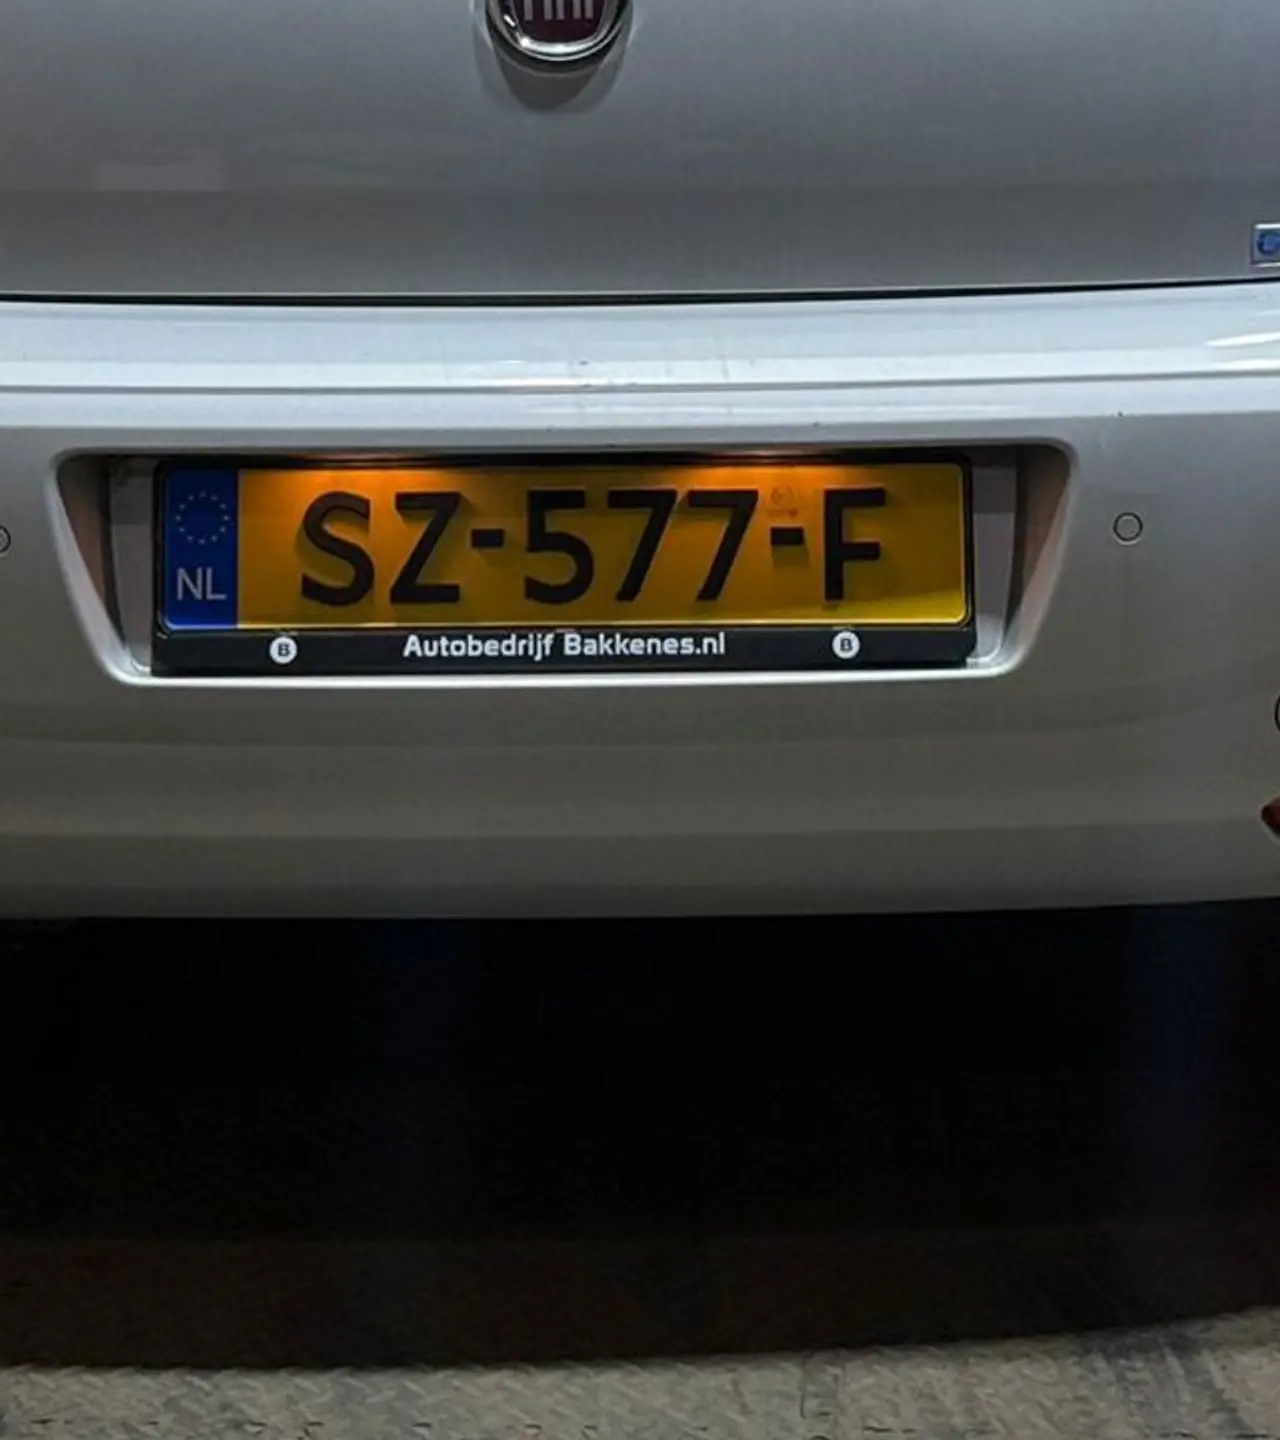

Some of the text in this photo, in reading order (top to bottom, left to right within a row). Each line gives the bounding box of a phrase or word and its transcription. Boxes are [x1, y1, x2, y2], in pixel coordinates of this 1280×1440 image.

[299, 487, 887, 607] SZ-577-F
[176, 566, 228, 601] NL
[403, 632, 726, 661] Autobedrijf Bakkenes.nl
